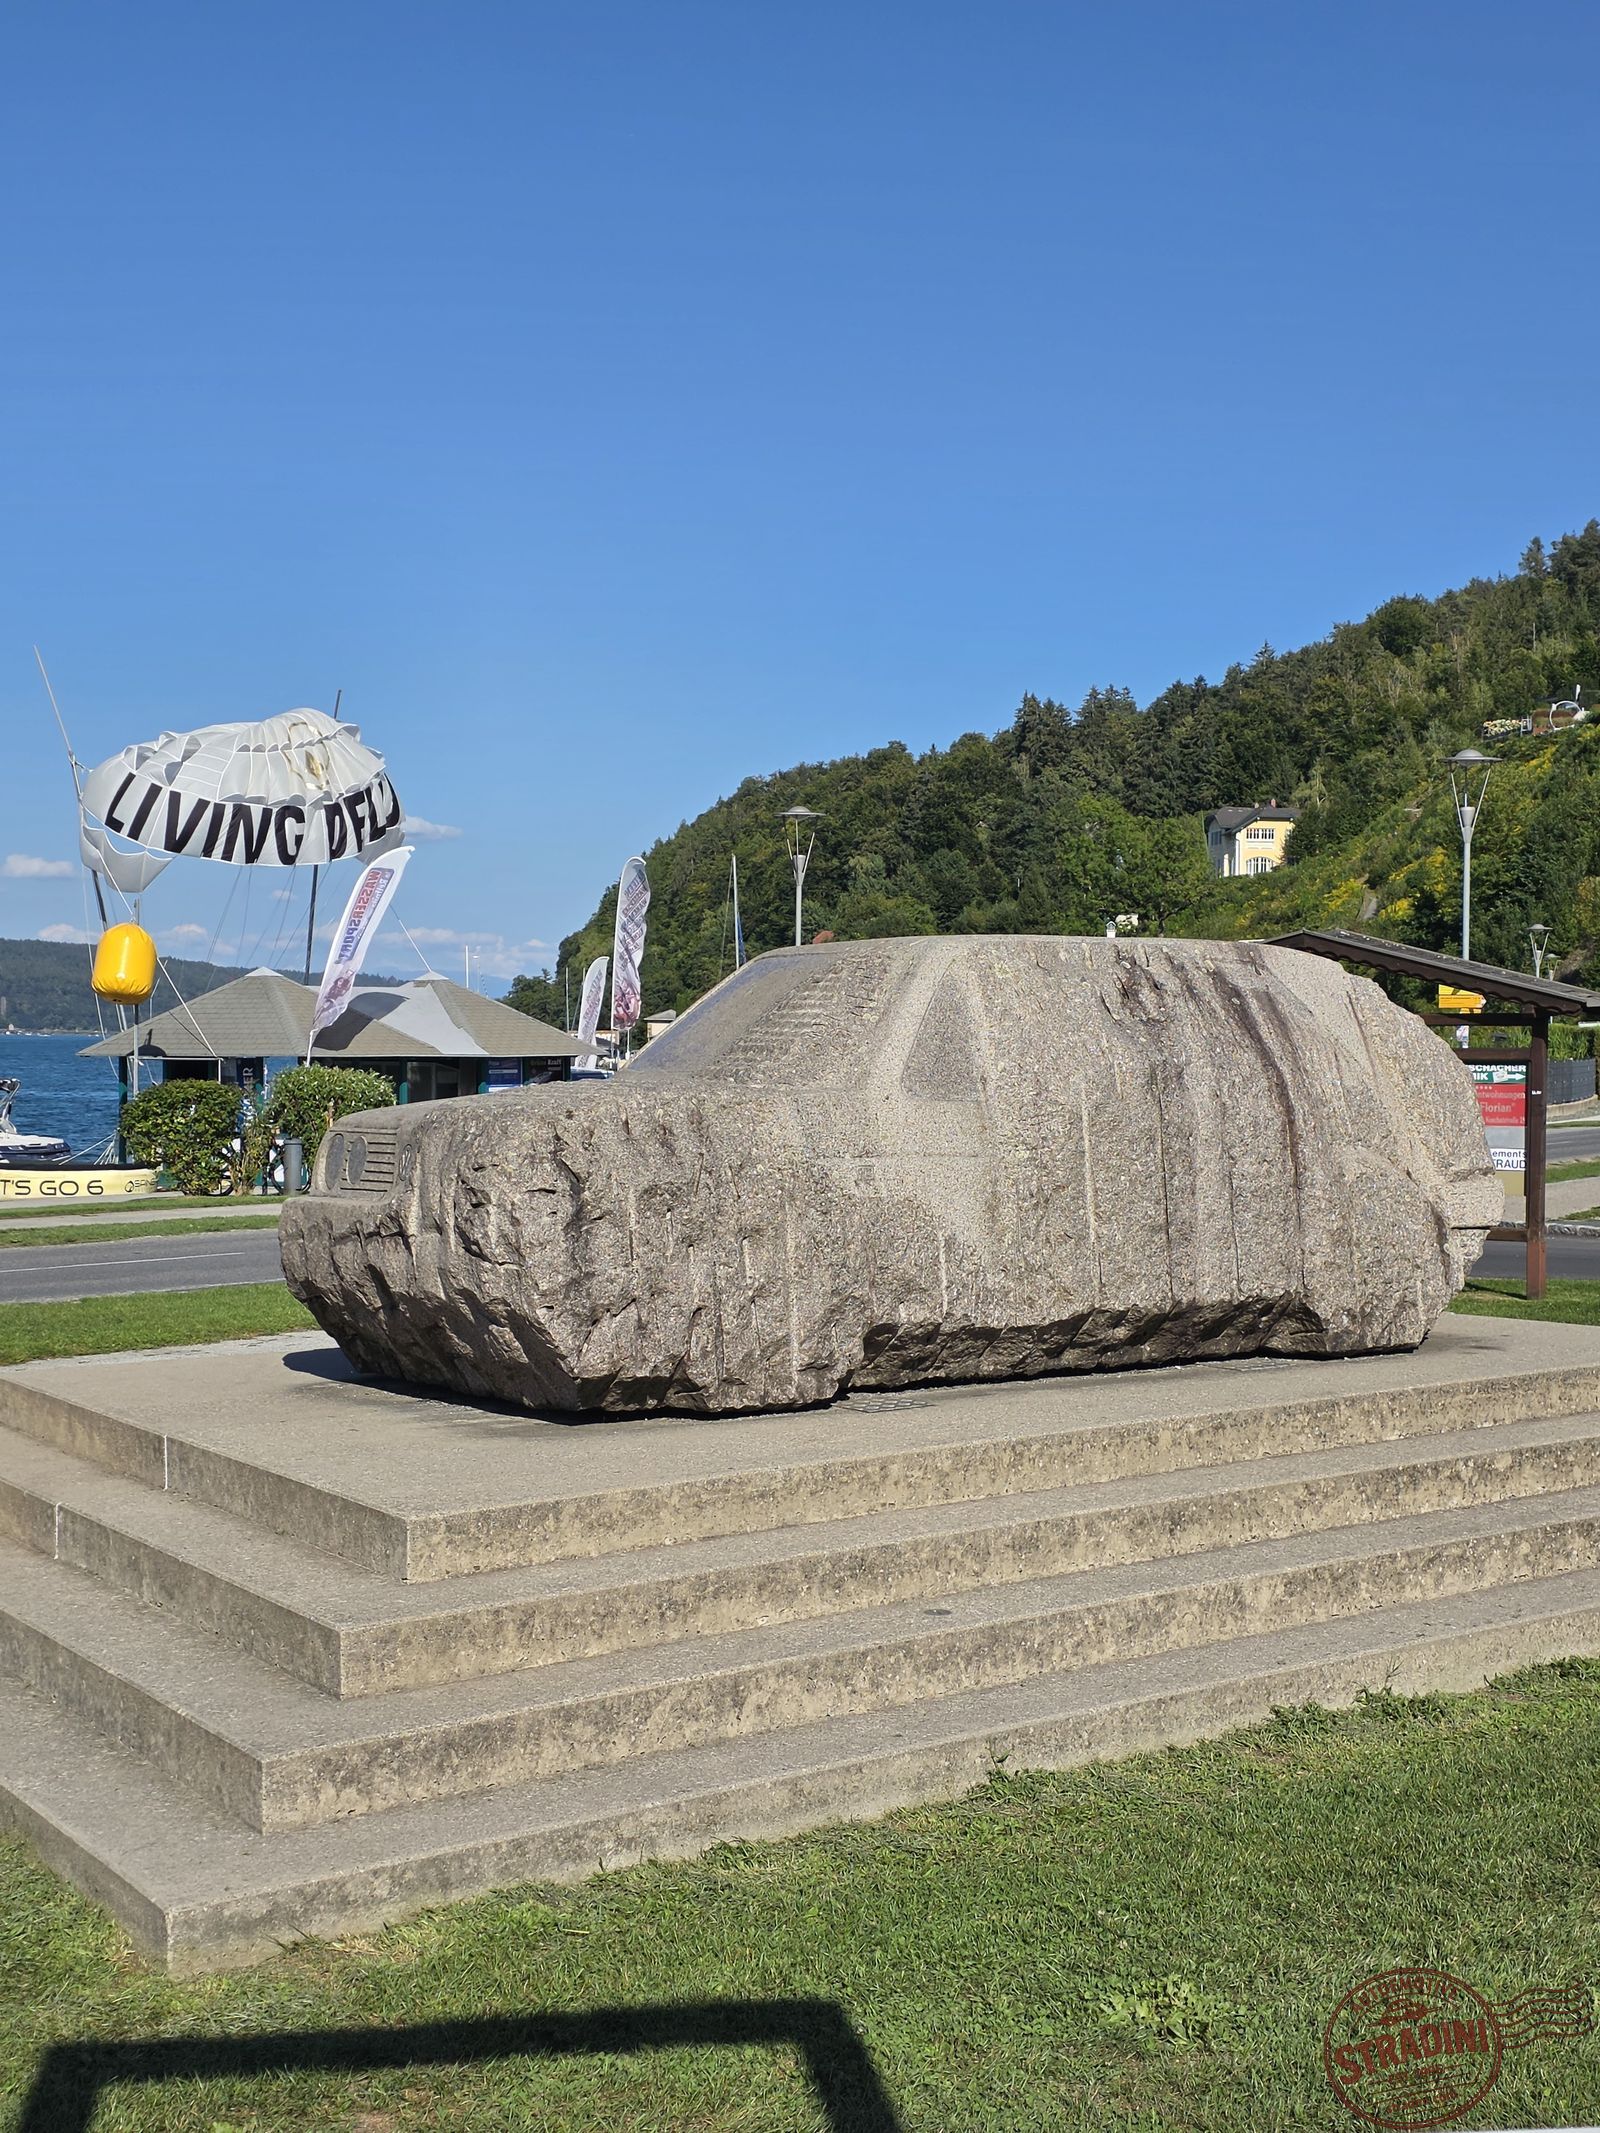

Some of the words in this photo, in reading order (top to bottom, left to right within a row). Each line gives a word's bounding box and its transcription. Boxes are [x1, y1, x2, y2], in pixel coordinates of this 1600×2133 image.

[104, 772, 305, 865] LIVING
[1493, 1159, 1527, 1169] RAUD
[39, 1180, 79, 1196] GO
[87, 1179, 104, 1195] 6
